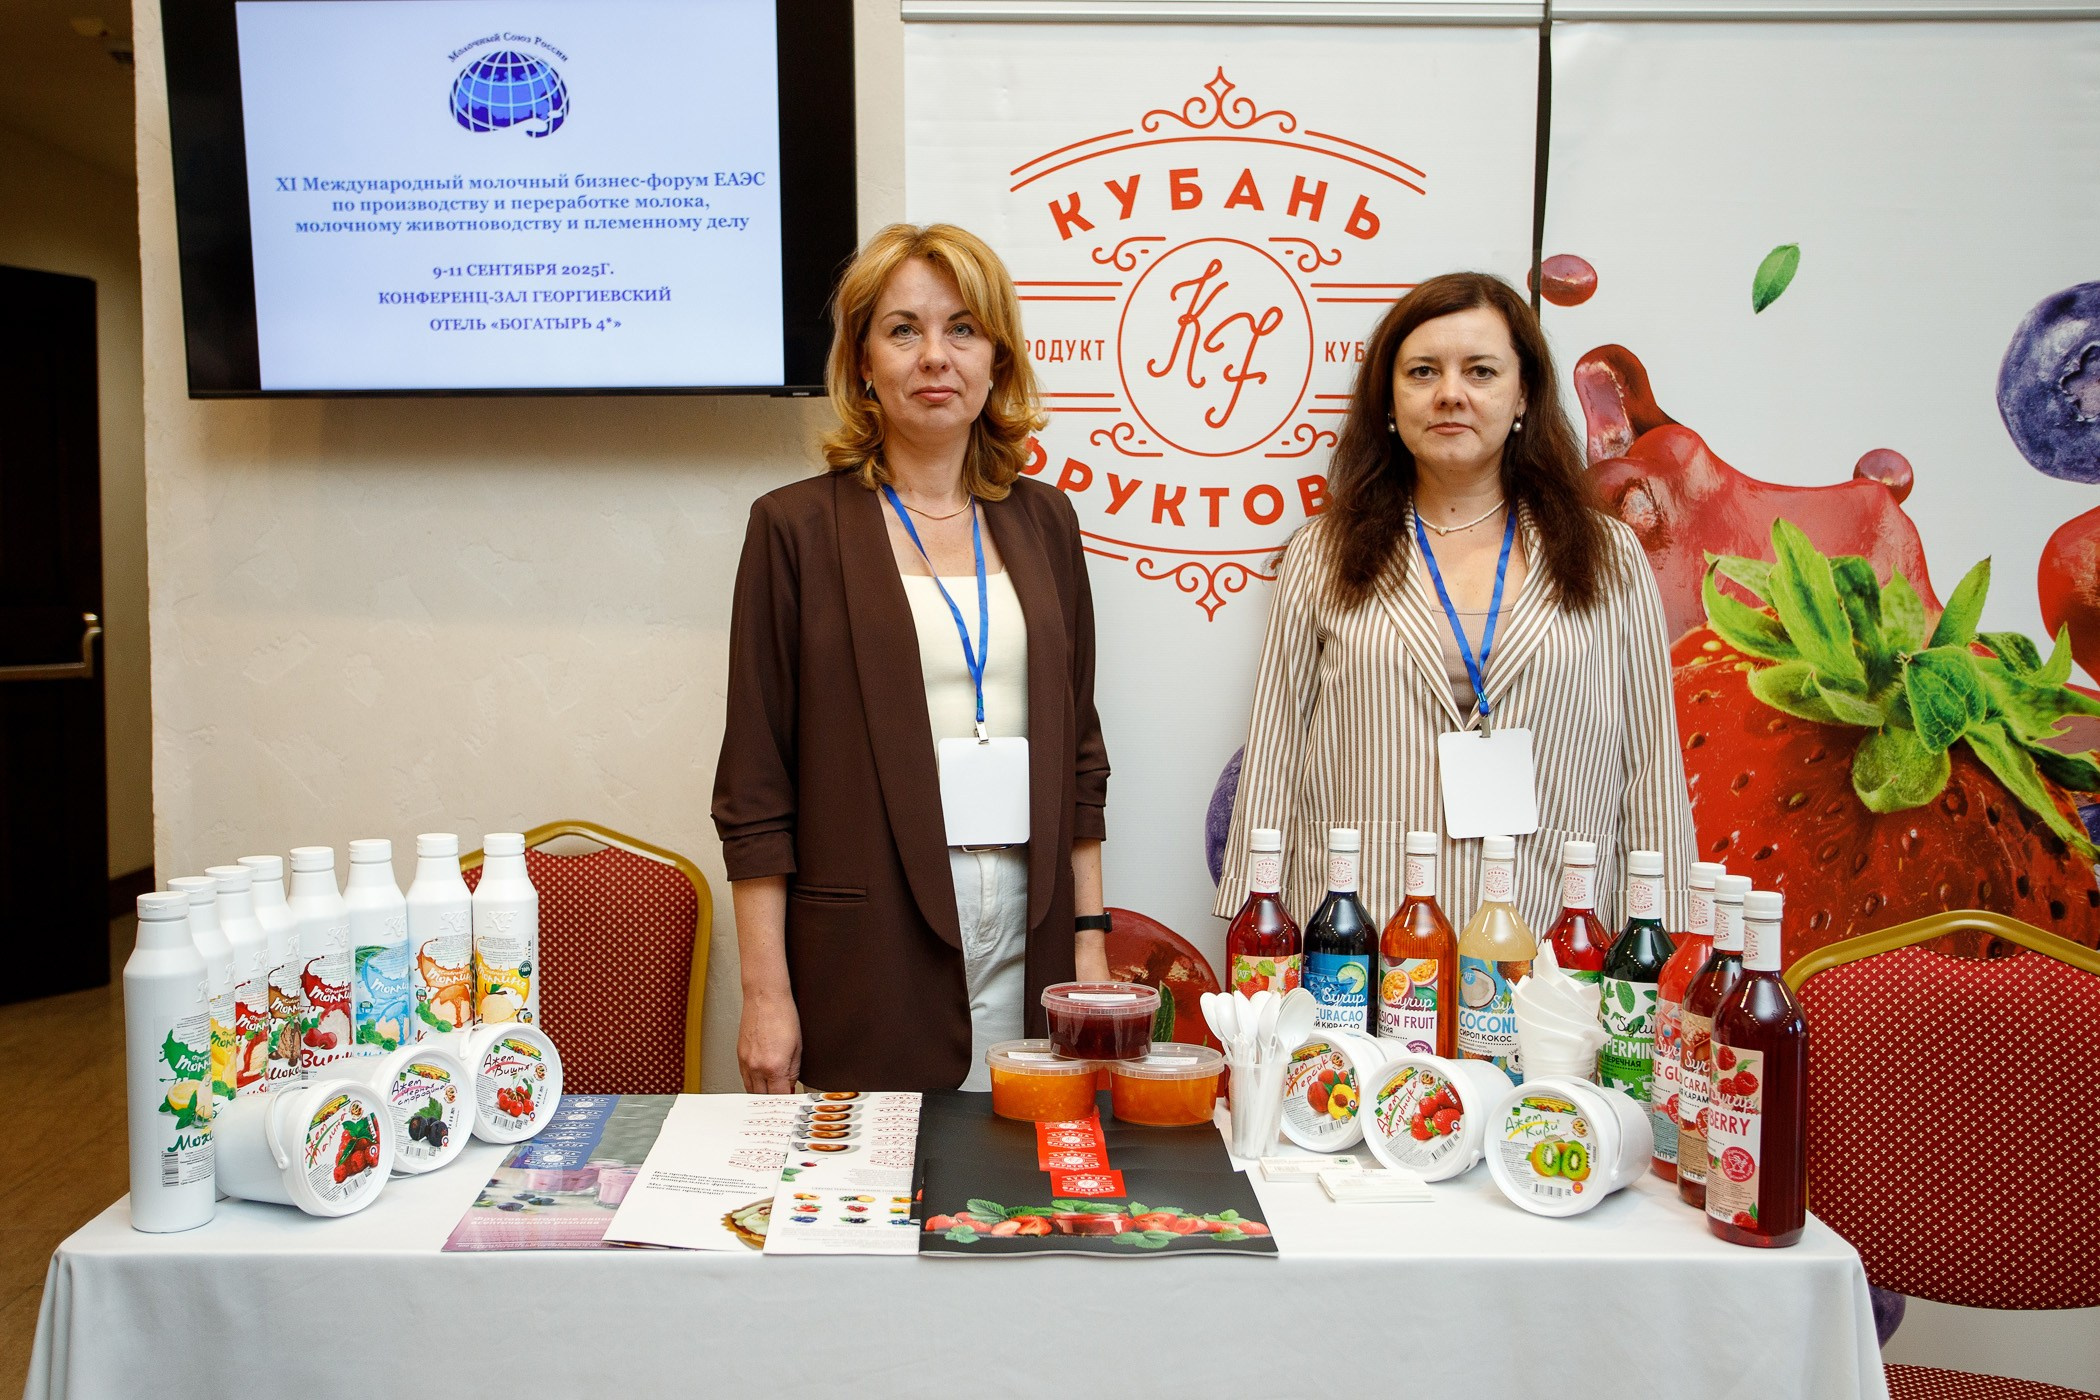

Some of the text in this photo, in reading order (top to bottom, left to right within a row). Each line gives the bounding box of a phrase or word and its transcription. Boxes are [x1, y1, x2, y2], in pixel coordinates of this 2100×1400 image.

[448, 32, 568, 62] Молочный Союз России
[276, 172, 766, 194] XI Международный молочный бизнес-форум ЕАЭС
[332, 195, 710, 214] по производству и переработке молока,
[1048, 167, 1382, 241] КУБАНЬ
[296, 217, 749, 235] молочному животноводству и племенному делу
[432, 263, 614, 279] 9-11 СЕНТЯБРЯ 2025Г.
[378, 286, 671, 307] КОНФЕРЕНЦ-ЗАЛ ГЕОРГИЕВСКИЙ
[430, 318, 487, 332] ОТЕЛЬ
[491, 317, 592, 331] «БОГАТЫРЬ
[1321, 986, 1366, 1008] Syrup
[1390, 989, 1435, 1012] Syrup
[1315, 1007, 1364, 1023] URACAO
[1404, 1016, 1435, 1030] FRUIT
[1459, 1028, 1512, 1043] СИРОП КОКОС
[484, 1053, 515, 1068] Джем
[391, 1079, 422, 1096] Джем
[1505, 1113, 1543, 1133] Джем
